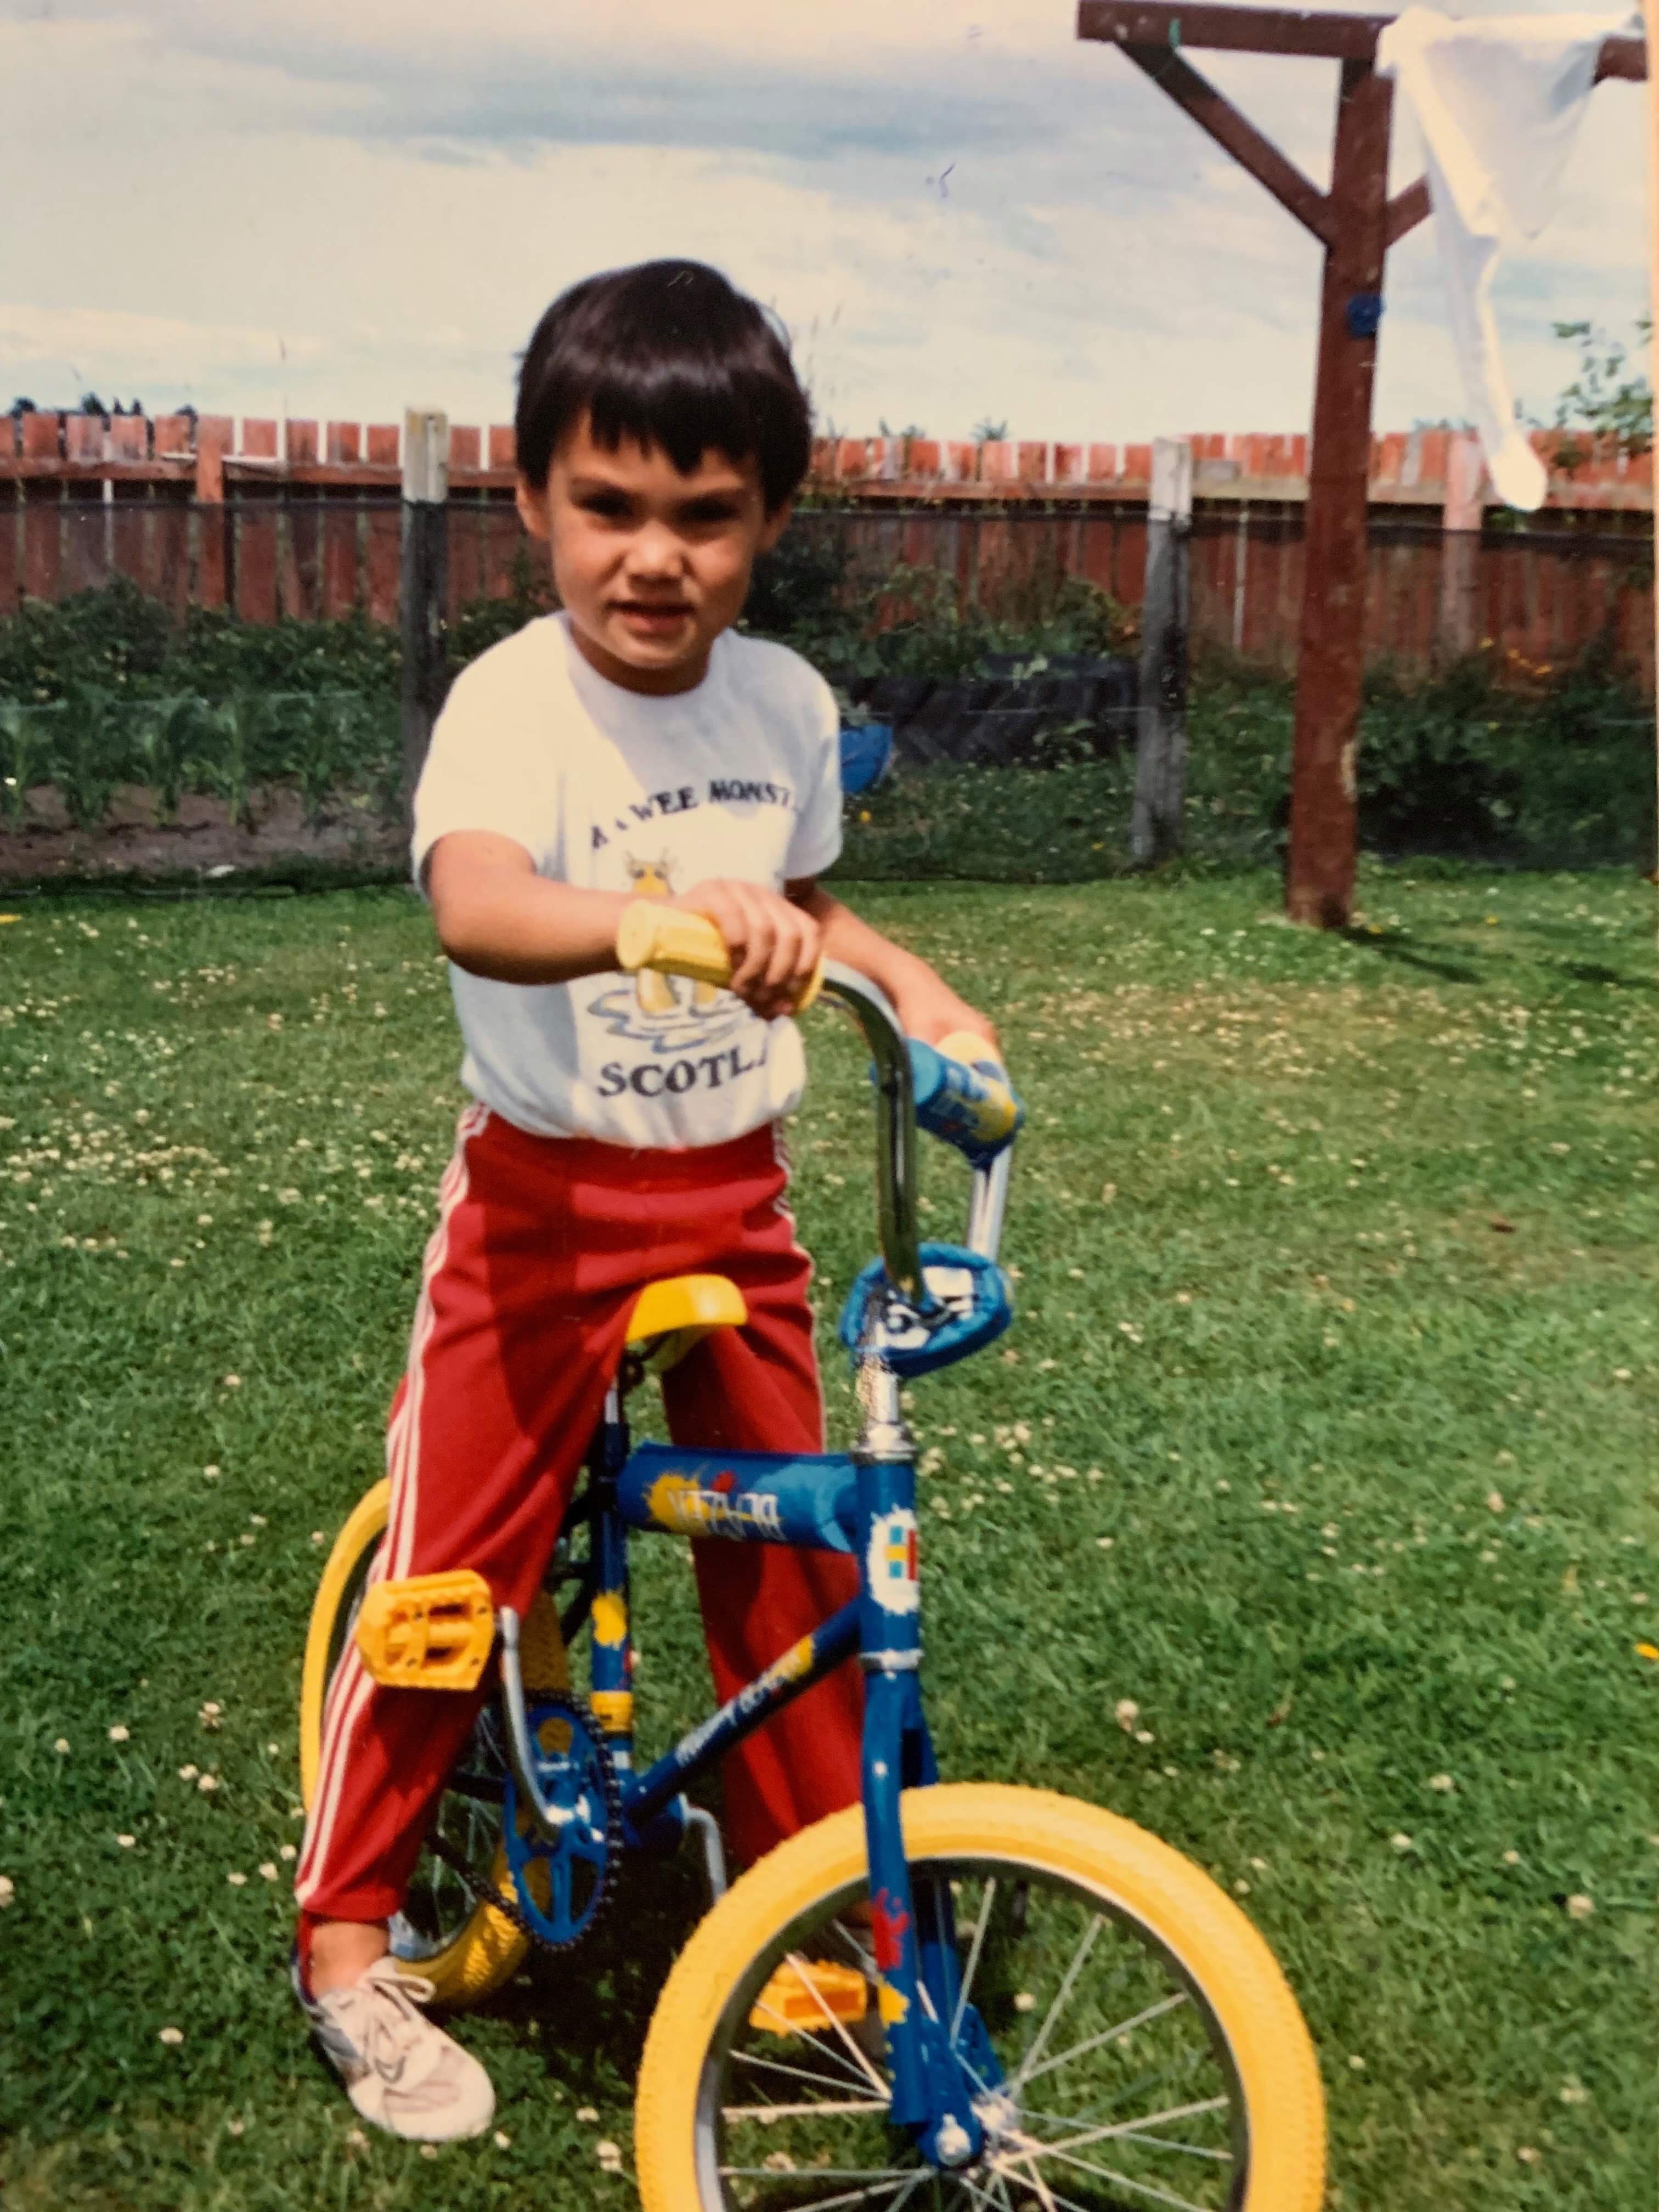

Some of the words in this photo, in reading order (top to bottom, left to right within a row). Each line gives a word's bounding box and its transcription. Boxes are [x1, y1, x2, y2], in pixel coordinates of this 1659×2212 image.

[629, 786, 698, 821] WEE
[709, 779, 791, 807] MONST
[597, 1045, 766, 1097] SCOTL
